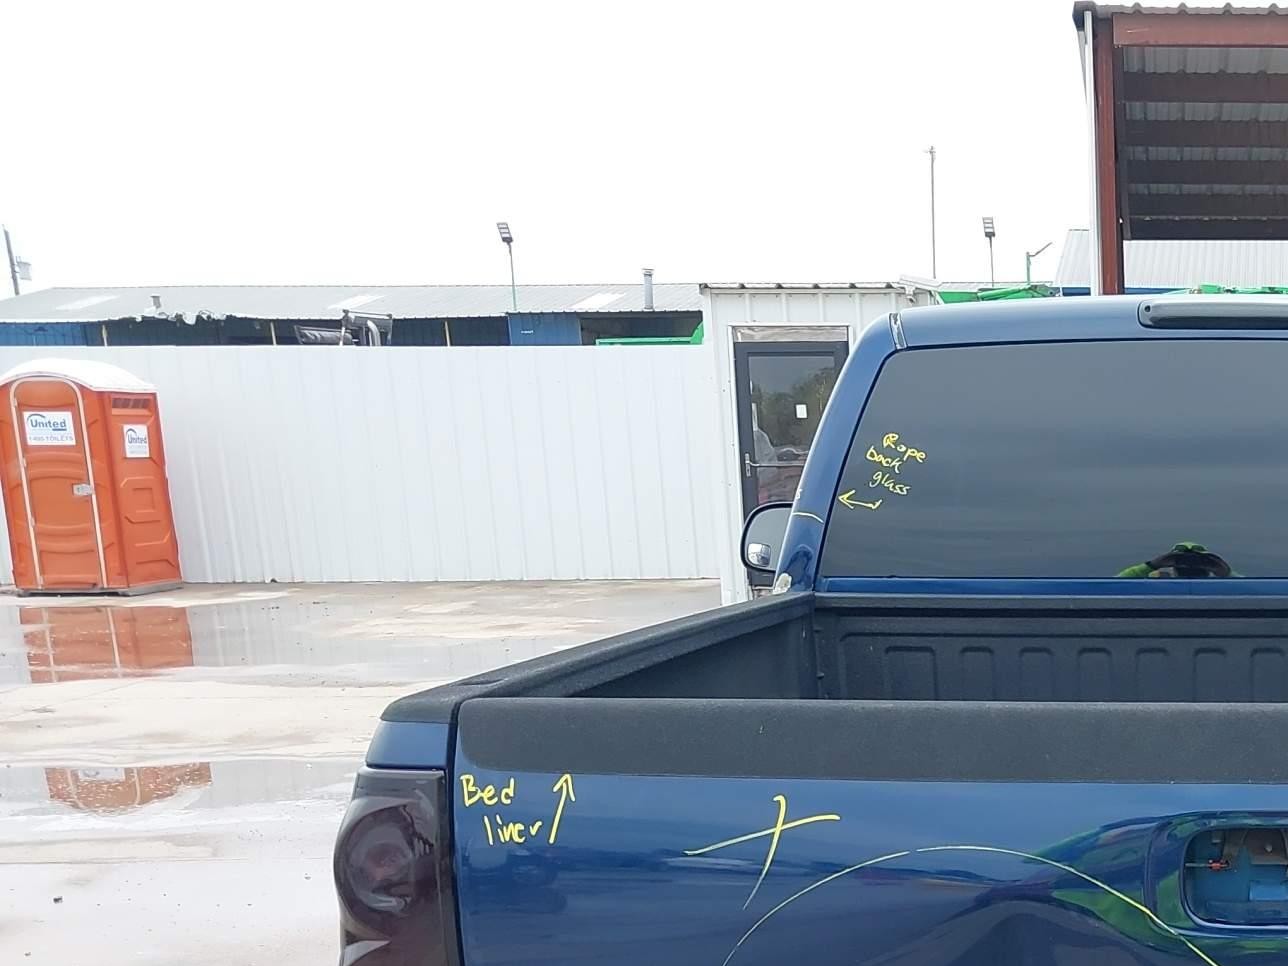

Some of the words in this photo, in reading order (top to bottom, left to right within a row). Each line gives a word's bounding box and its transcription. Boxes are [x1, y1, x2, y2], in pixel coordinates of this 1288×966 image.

[30, 418, 66, 428] United
[882, 432, 927, 463] Rope
[868, 471, 911, 495] glass
[460, 774, 516, 807] Bed
[483, 814, 543, 846] liner
